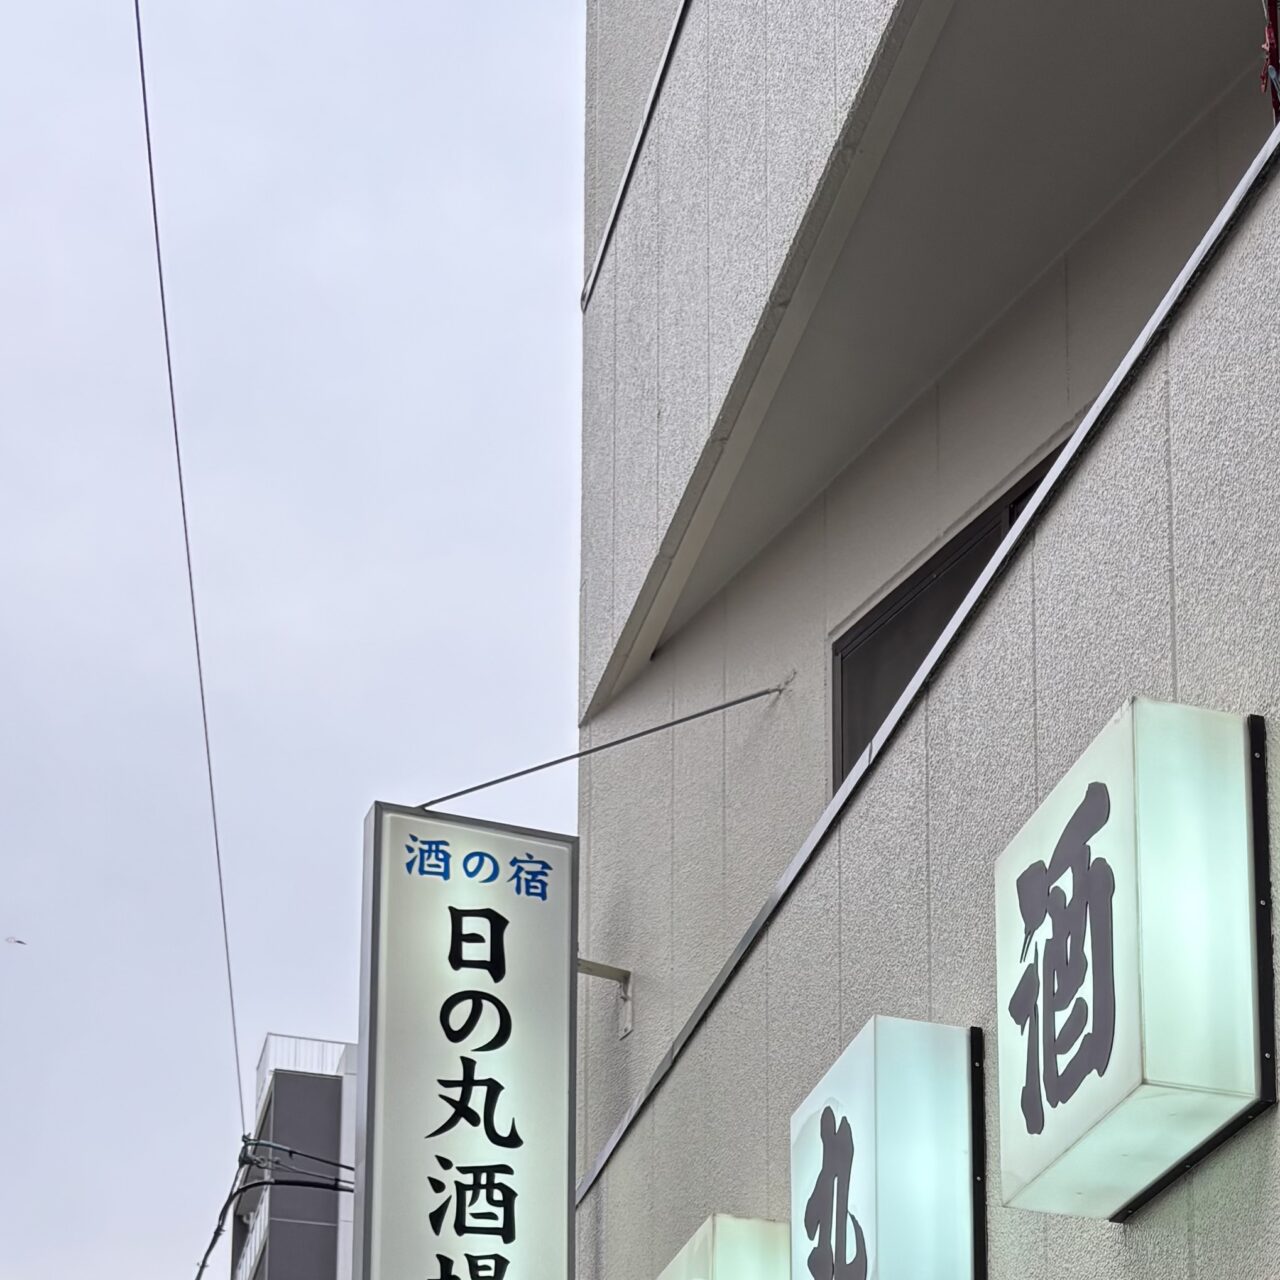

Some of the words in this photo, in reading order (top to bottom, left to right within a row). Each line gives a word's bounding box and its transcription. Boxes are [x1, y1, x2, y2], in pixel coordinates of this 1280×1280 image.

[405, 833, 553, 901] 酒の宿
[1009, 781, 1115, 1135] 酒
